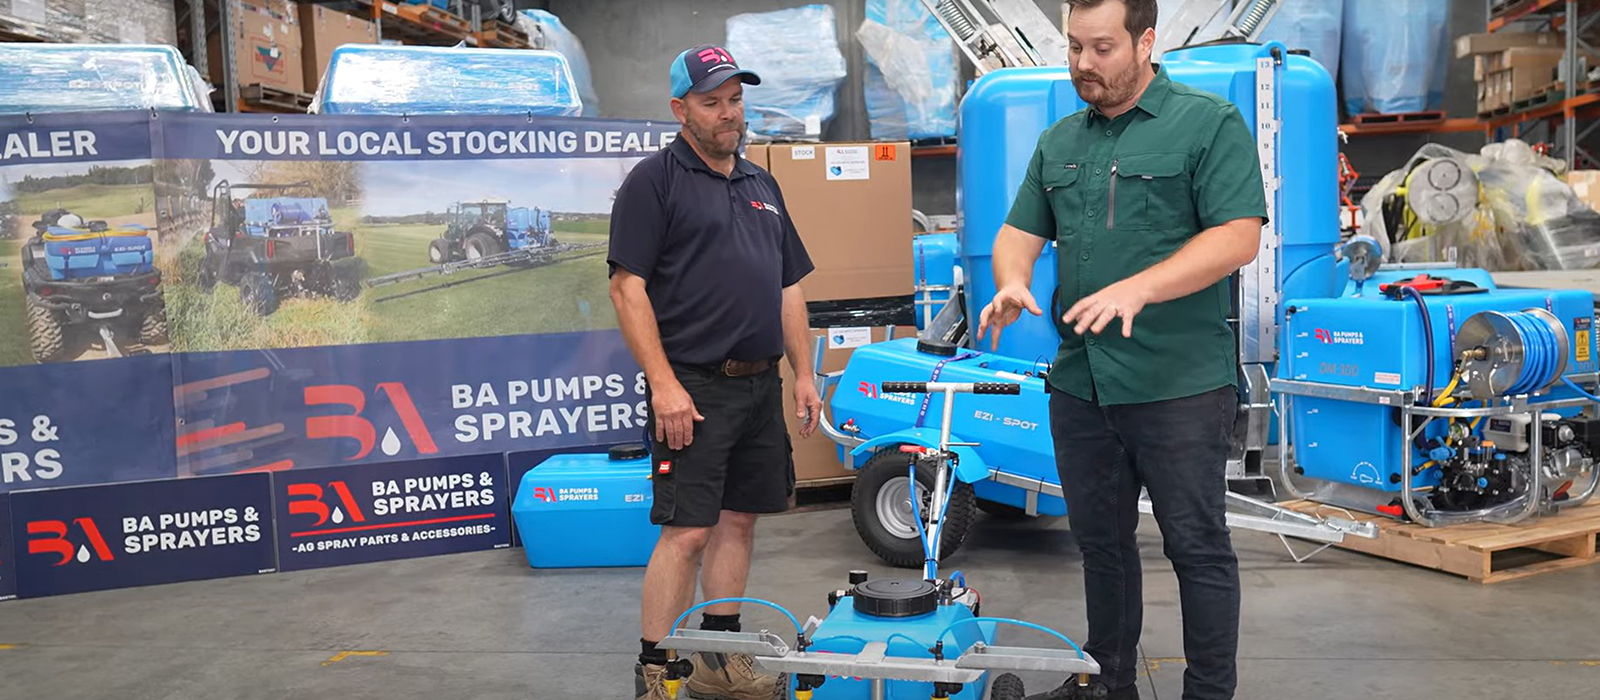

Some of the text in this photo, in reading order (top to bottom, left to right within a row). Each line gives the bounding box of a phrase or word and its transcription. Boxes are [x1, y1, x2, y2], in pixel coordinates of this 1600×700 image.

[1260, 60, 1270, 69] 13
[1260, 102, 1270, 110] 11
[1260, 122, 1271, 130] 10
[0, 130, 98, 159] ALER
[216, 129, 677, 156] YOUR LOCAL STOCKING DEALE
[1264, 266, 1270, 274] 3
[1333, 337, 1364, 345] SPRAYERS
[1341, 331, 1358, 339] PUMPS
[452, 382, 498, 408] BA
[508, 373, 625, 405] PUMPS
[880, 392, 915, 405] SPRAYERS
[31, 414, 59, 442] &
[304, 382, 439, 460] BA
[454, 400, 648, 443] SPRAYERS
[974, 410, 994, 422] EZI
[1003, 416, 1039, 431] SPOT
[372, 471, 494, 497] BA PUMPS &
[534, 486, 557, 503] BA
[286, 480, 366, 527] BA
[373, 487, 496, 516] SPRAYERS
[559, 493, 599, 502] SPRAYERS
[624, 493, 645, 503] EZI
[122, 506, 260, 534] BA PUMPS &
[27, 517, 115, 567] BA
[124, 523, 262, 554] SPRAYERS
[316, 536, 358, 551] SPRAY
[359, 532, 399, 549] PARTS
[401, 531, 410, 543] &
